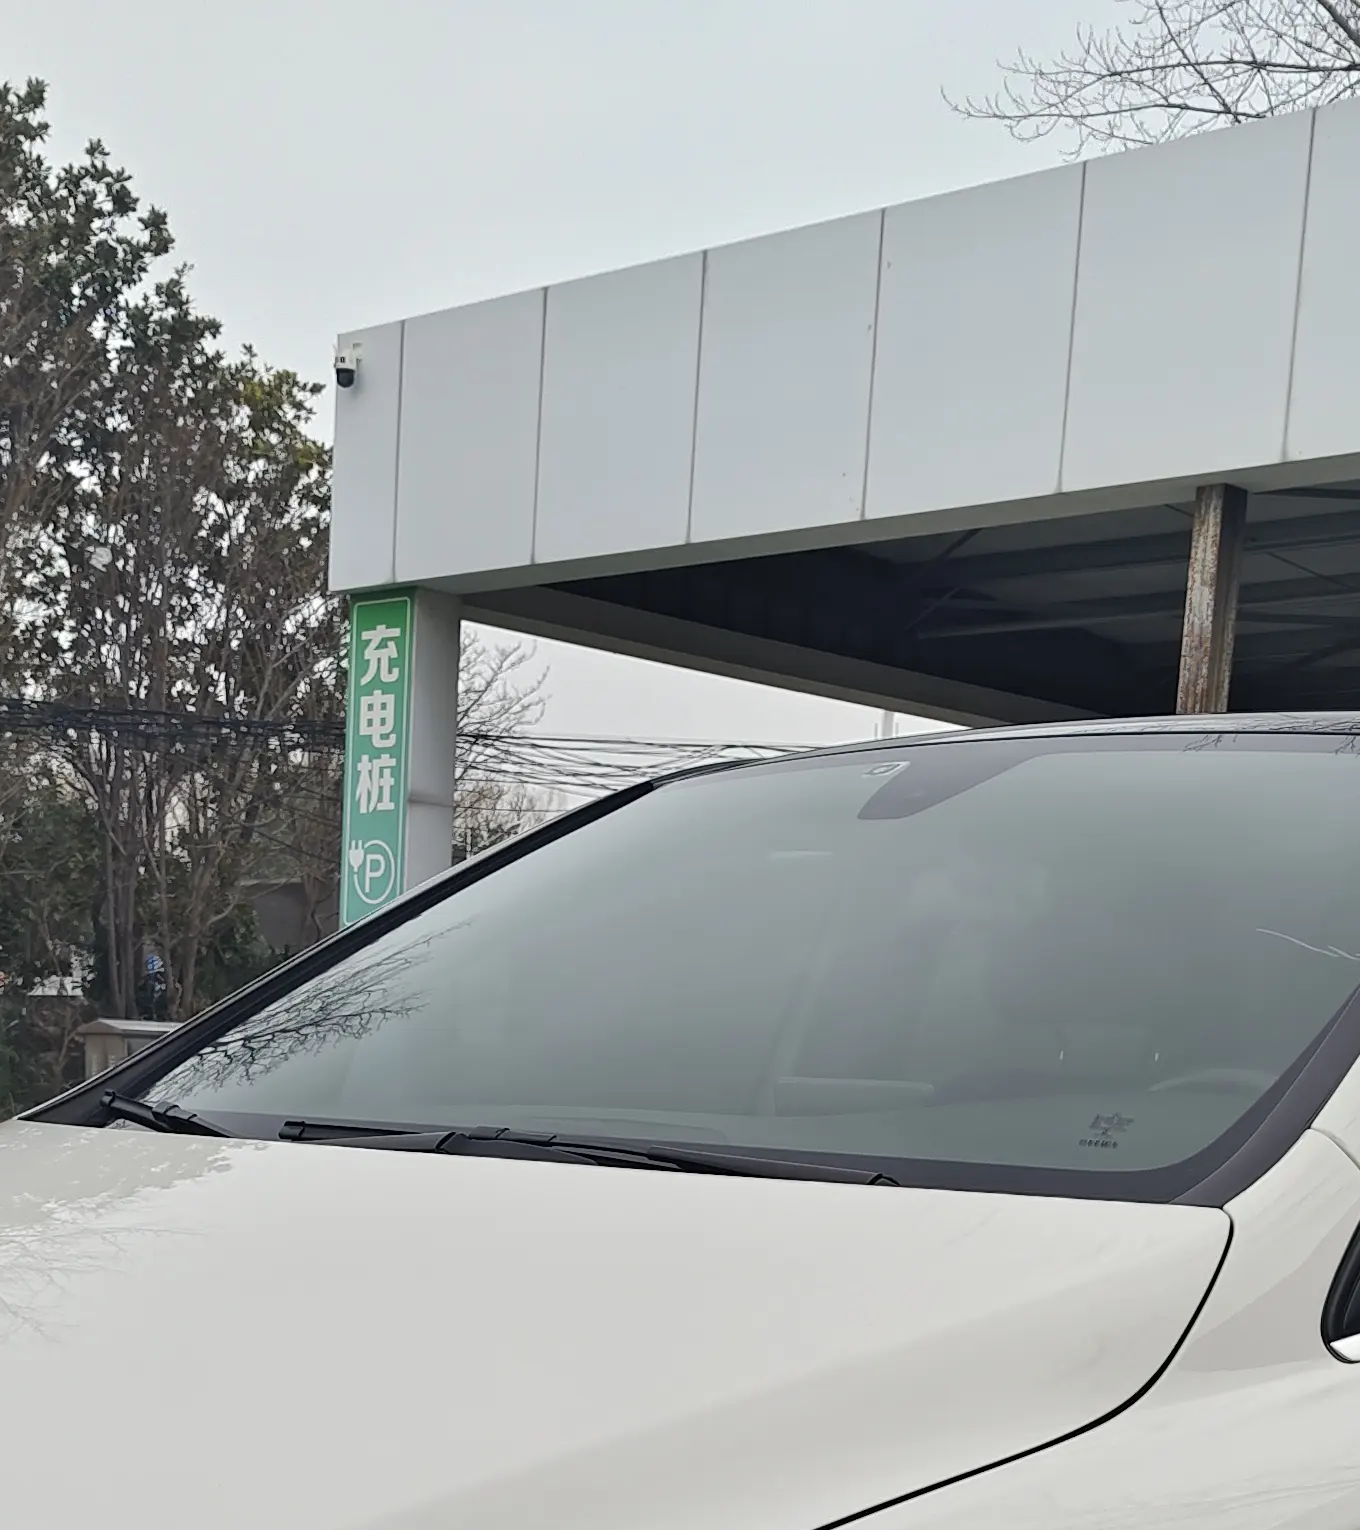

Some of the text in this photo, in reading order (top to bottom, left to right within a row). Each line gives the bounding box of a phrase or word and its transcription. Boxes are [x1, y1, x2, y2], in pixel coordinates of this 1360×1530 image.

[355, 624, 402, 814] 充电桩
[364, 853, 386, 893] P
